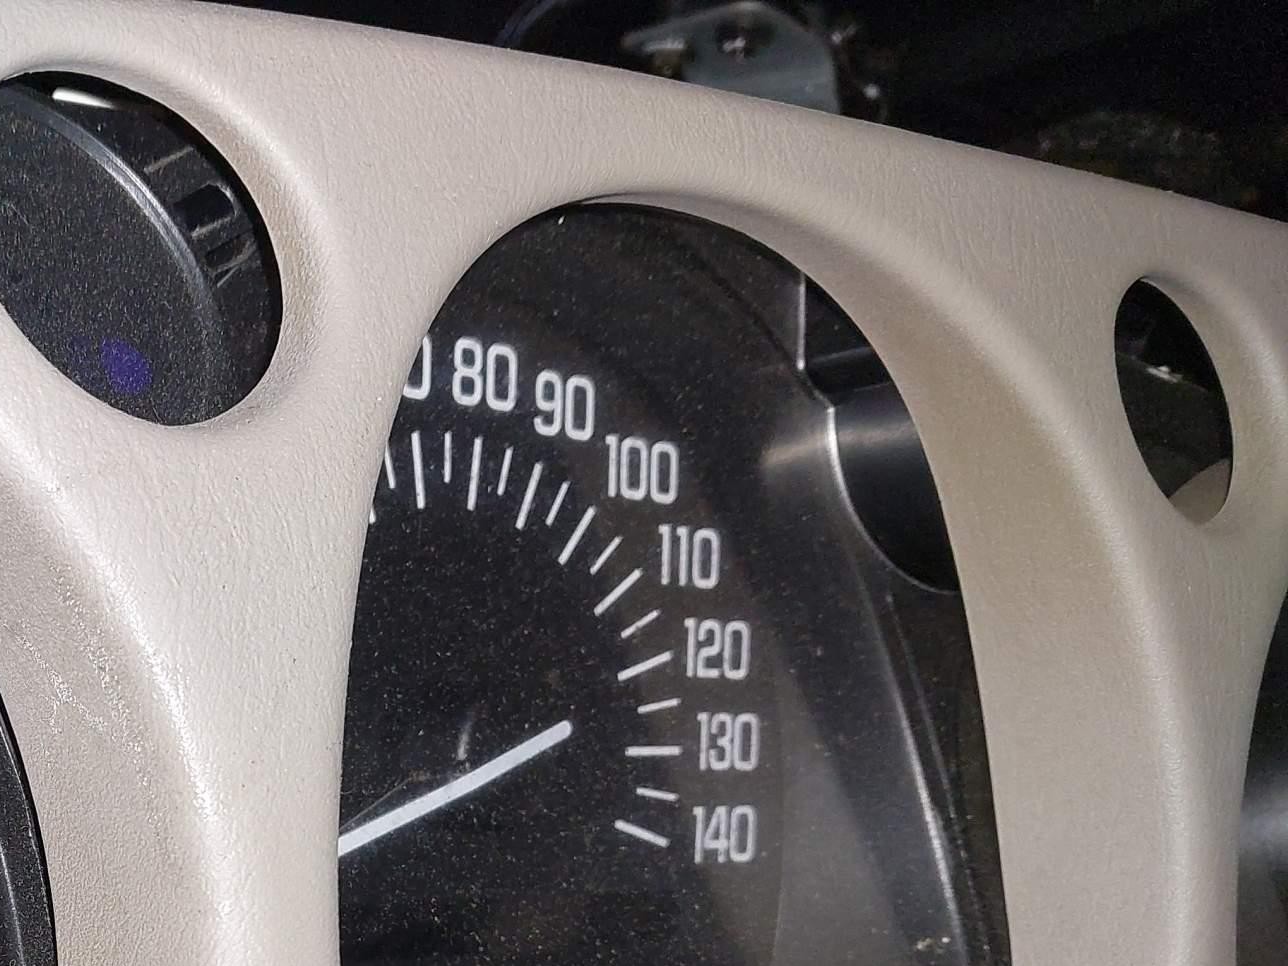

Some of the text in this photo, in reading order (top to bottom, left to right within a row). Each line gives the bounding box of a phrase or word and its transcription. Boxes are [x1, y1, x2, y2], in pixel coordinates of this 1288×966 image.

[452, 336, 518, 412] 80
[533, 369, 595, 441] 90
[605, 433, 679, 504] 100
[658, 524, 720, 588] 110
[683, 617, 751, 680] 120
[696, 712, 759, 771] 130
[692, 805, 757, 864] 140
